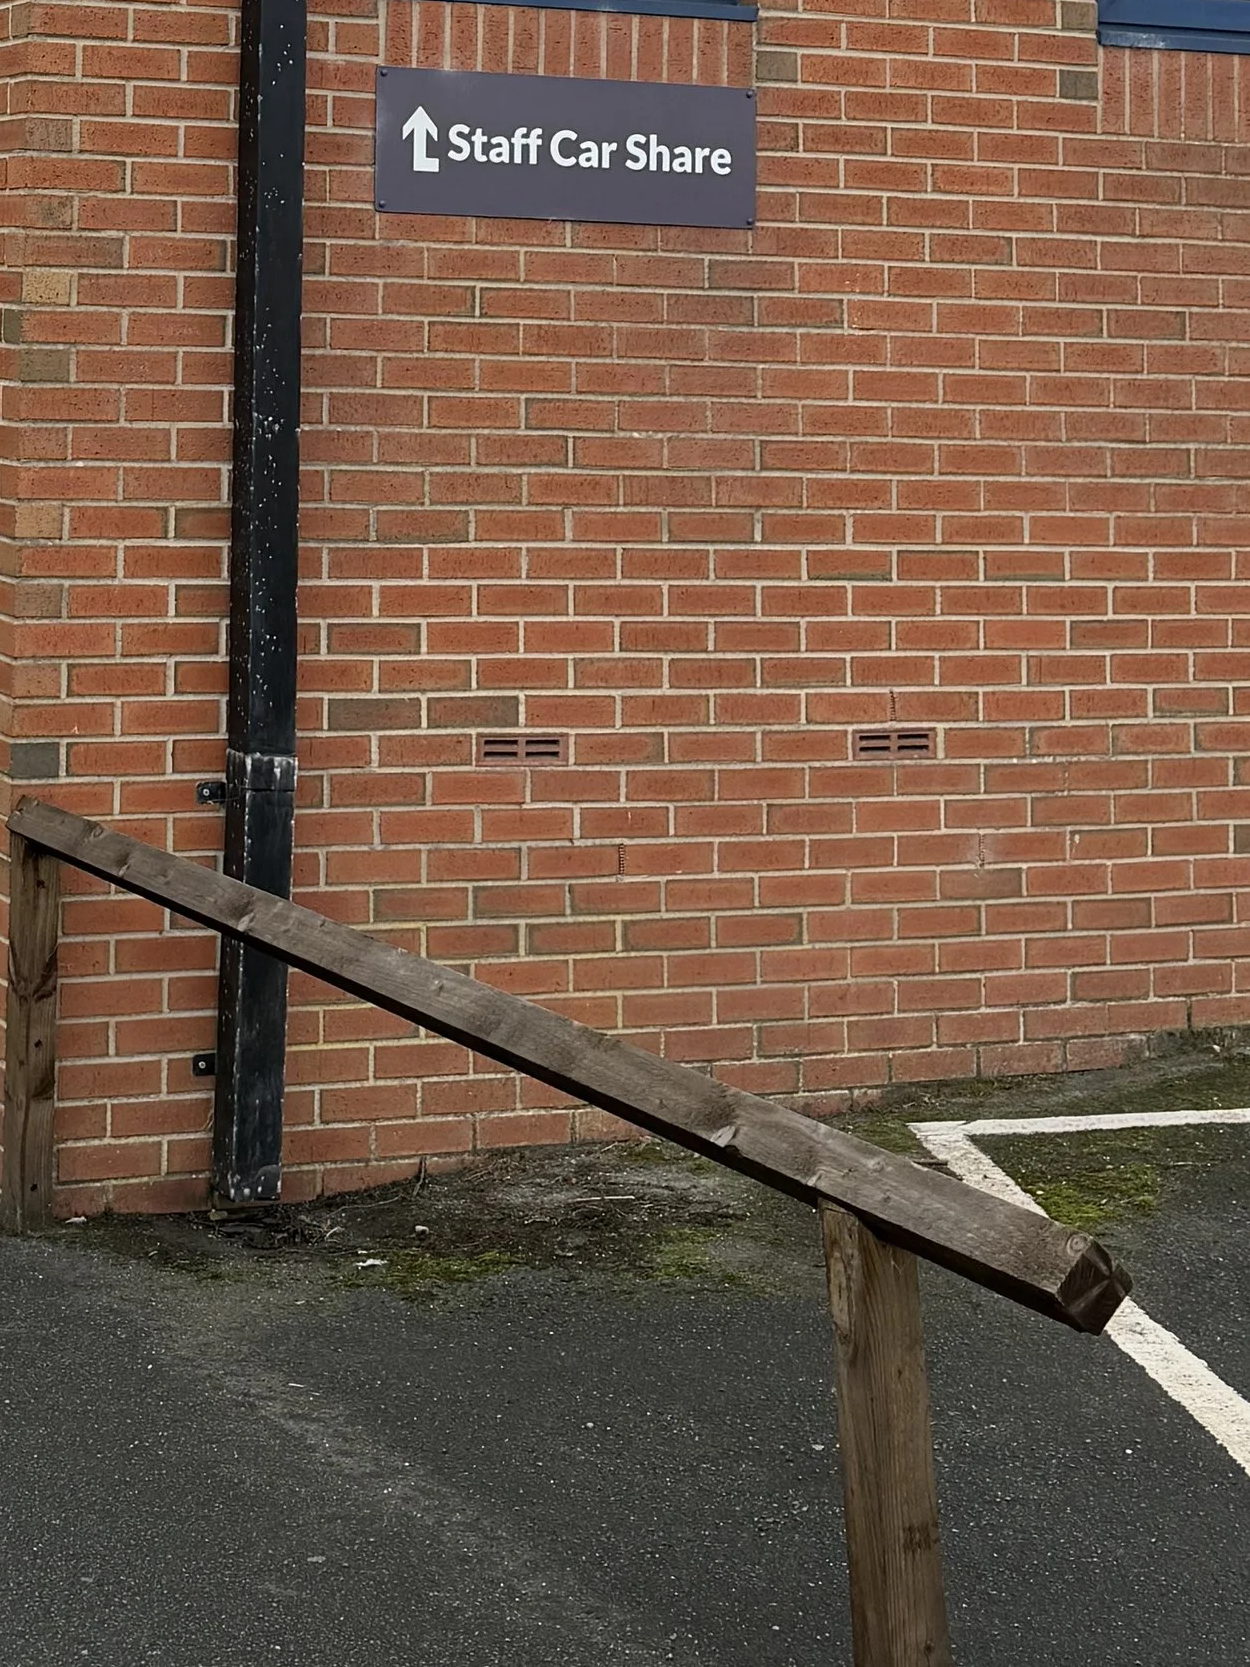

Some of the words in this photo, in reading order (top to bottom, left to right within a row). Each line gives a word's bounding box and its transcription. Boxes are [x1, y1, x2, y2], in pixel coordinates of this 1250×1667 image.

[447, 123, 543, 165] Staff
[549, 129, 618, 169] Car
[624, 133, 732, 176] Share
